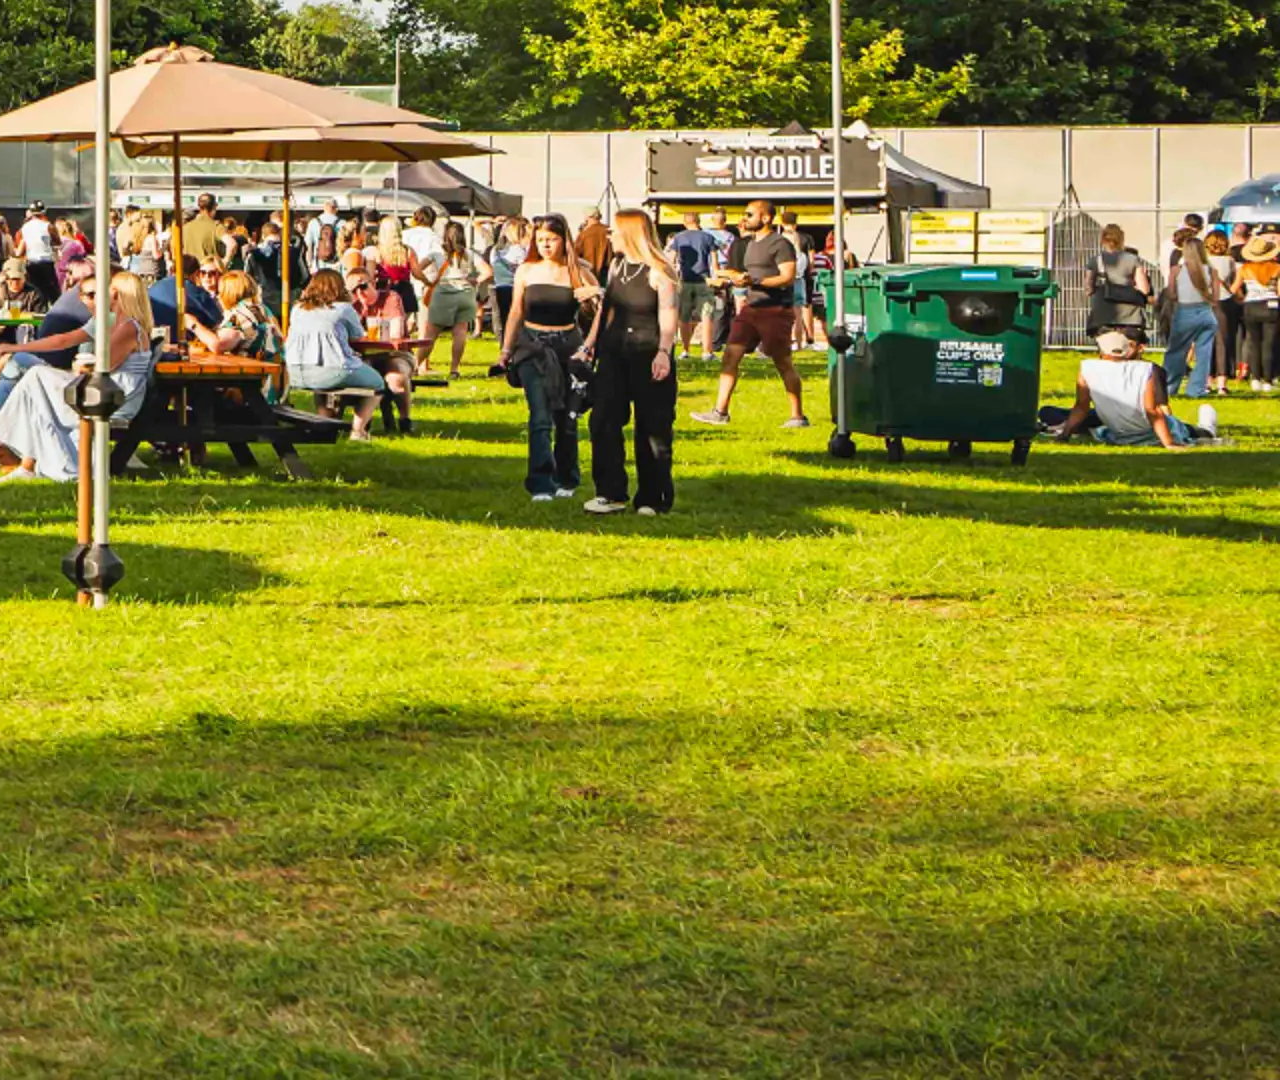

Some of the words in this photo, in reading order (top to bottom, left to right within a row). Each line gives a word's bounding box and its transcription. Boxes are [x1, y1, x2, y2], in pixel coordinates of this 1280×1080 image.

[735, 155, 834, 179] NOODLE
[939, 341, 1004, 352] REUSABLE
[936, 351, 971, 360] CUPS
[973, 352, 1005, 361] ONLY
